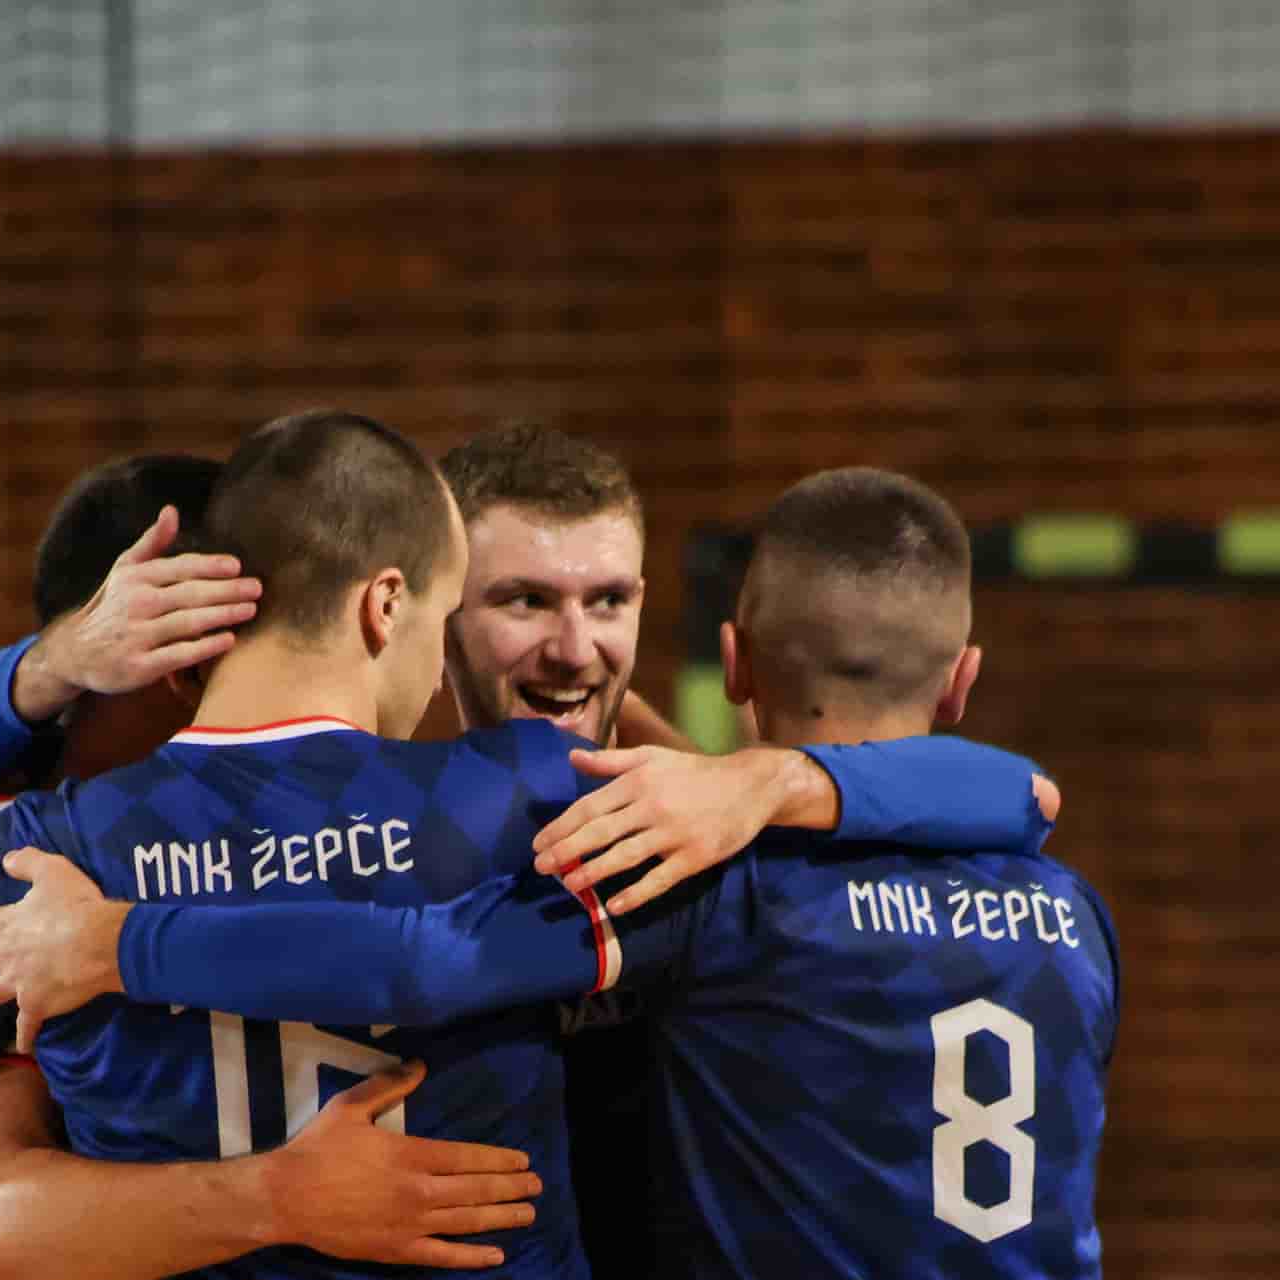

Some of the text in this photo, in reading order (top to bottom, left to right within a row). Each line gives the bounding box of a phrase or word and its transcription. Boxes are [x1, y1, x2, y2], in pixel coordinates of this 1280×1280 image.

[133, 813, 415, 899] MNK ŽEPČE
[847, 878, 1081, 949] MNK ŽEPČE
[930, 997, 1036, 1243] 8
